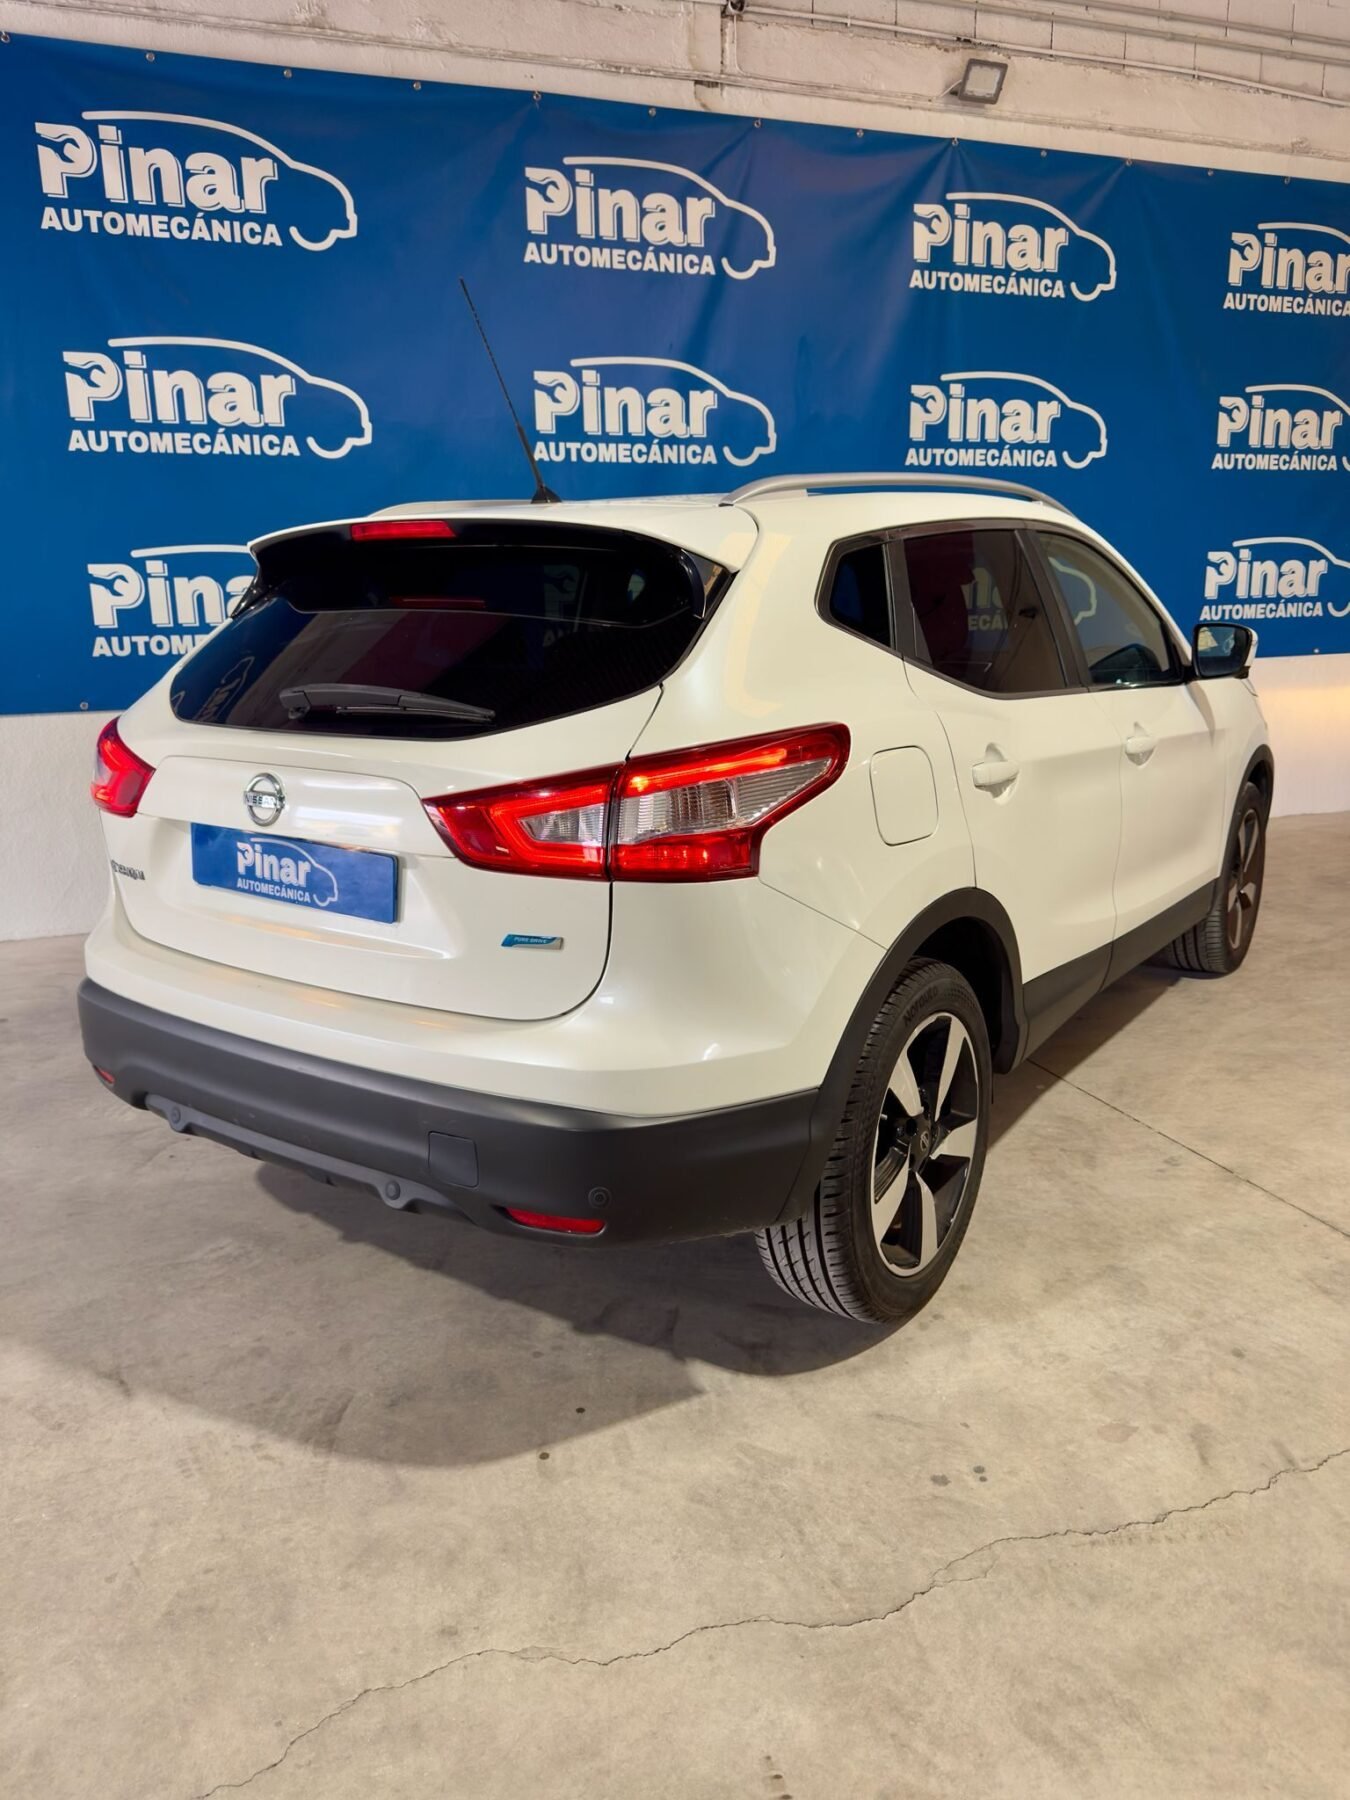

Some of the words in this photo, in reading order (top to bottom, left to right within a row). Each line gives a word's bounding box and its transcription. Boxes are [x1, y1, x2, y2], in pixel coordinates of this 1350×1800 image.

[35, 122, 278, 214] Pinar
[41, 206, 283, 247] AUTOMECÁNICA
[525, 166, 715, 247] Pinar
[524, 242, 715, 275] AUTOMECÁNICA
[912, 203, 1069, 273] Pinar
[909, 269, 1065, 298] AUTOMECÁNICA
[63, 351, 296, 427] Pinar
[533, 370, 717, 438] Pinar
[909, 384, 1060, 443] Pinar
[1217, 395, 1342, 449] Pinar
[68, 429, 300, 456] AUTOMECÁNICA
[533, 438, 717, 465] AUTOMECÁNICA
[905, 445, 1057, 467] AUTOMECÁNICA
[1211, 452, 1338, 471] AUTOMECÁNICA
[1205, 549, 1327, 599] Pinar
[1199, 599, 1323, 621] AUTOMECÁNICA
[237, 841, 311, 887] Pinar
[237, 878, 310, 903] AUTOMECÁNICA
